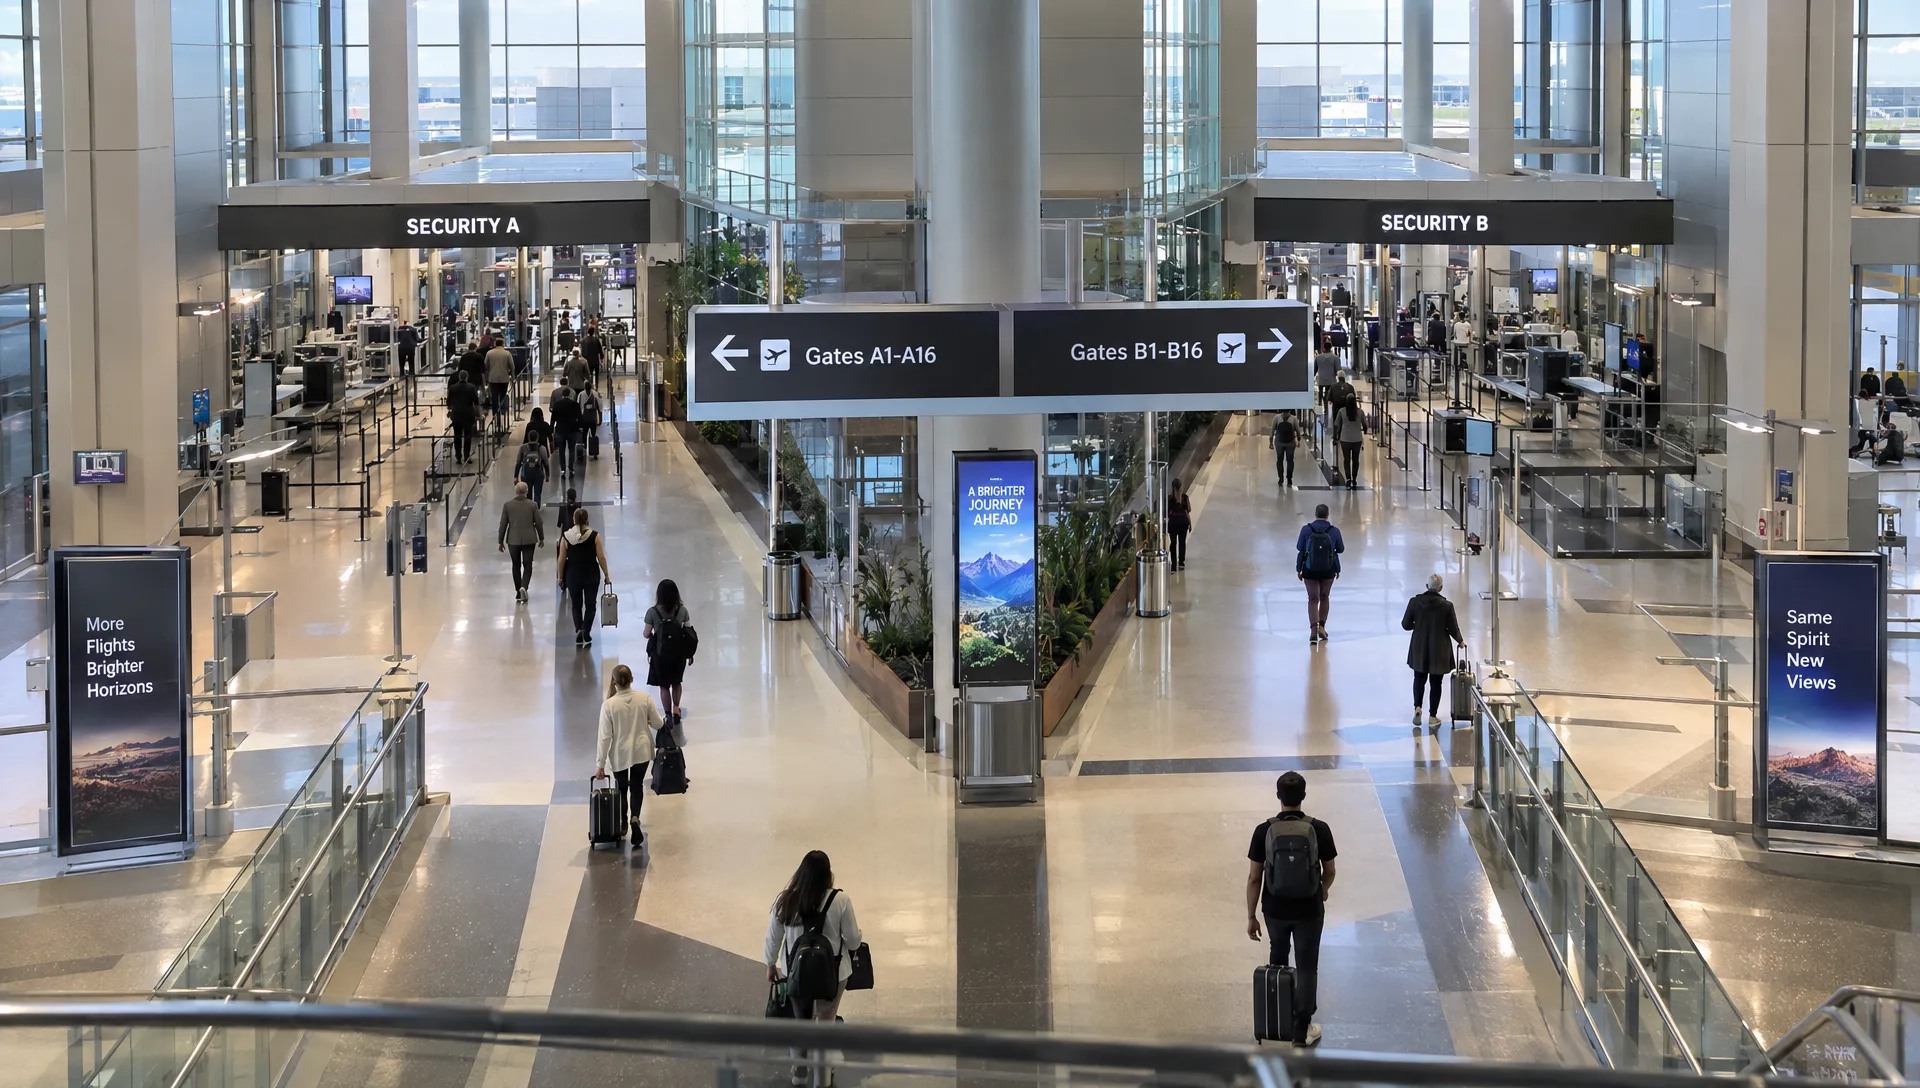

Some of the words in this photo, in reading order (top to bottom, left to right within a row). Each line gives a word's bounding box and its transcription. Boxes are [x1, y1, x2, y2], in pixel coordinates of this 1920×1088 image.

[406, 217, 500, 235] SECURITY
[505, 216, 521, 234] A
[1381, 214, 1471, 232] SECURITY
[1476, 215, 1489, 232] B
[805, 346, 864, 366] Gates
[869, 346, 937, 365] A1-A16
[1070, 343, 1128, 361] Gates
[1135, 341, 1203, 360] B1-B16
[968, 486, 976, 497] A
[977, 485, 1025, 497] BRIGHTER
[968, 498, 1024, 511] JOURNEY
[973, 512, 1018, 526] AHEAD
[86, 616, 125, 632] More
[1786, 609, 1833, 625] Same
[86, 637, 136, 656] Flights
[1786, 630, 1831, 649] Spirit
[86, 659, 145, 678] Brighter
[1786, 652, 1825, 668] New
[87, 681, 154, 699] Horizons
[1786, 673, 1837, 690] Views
